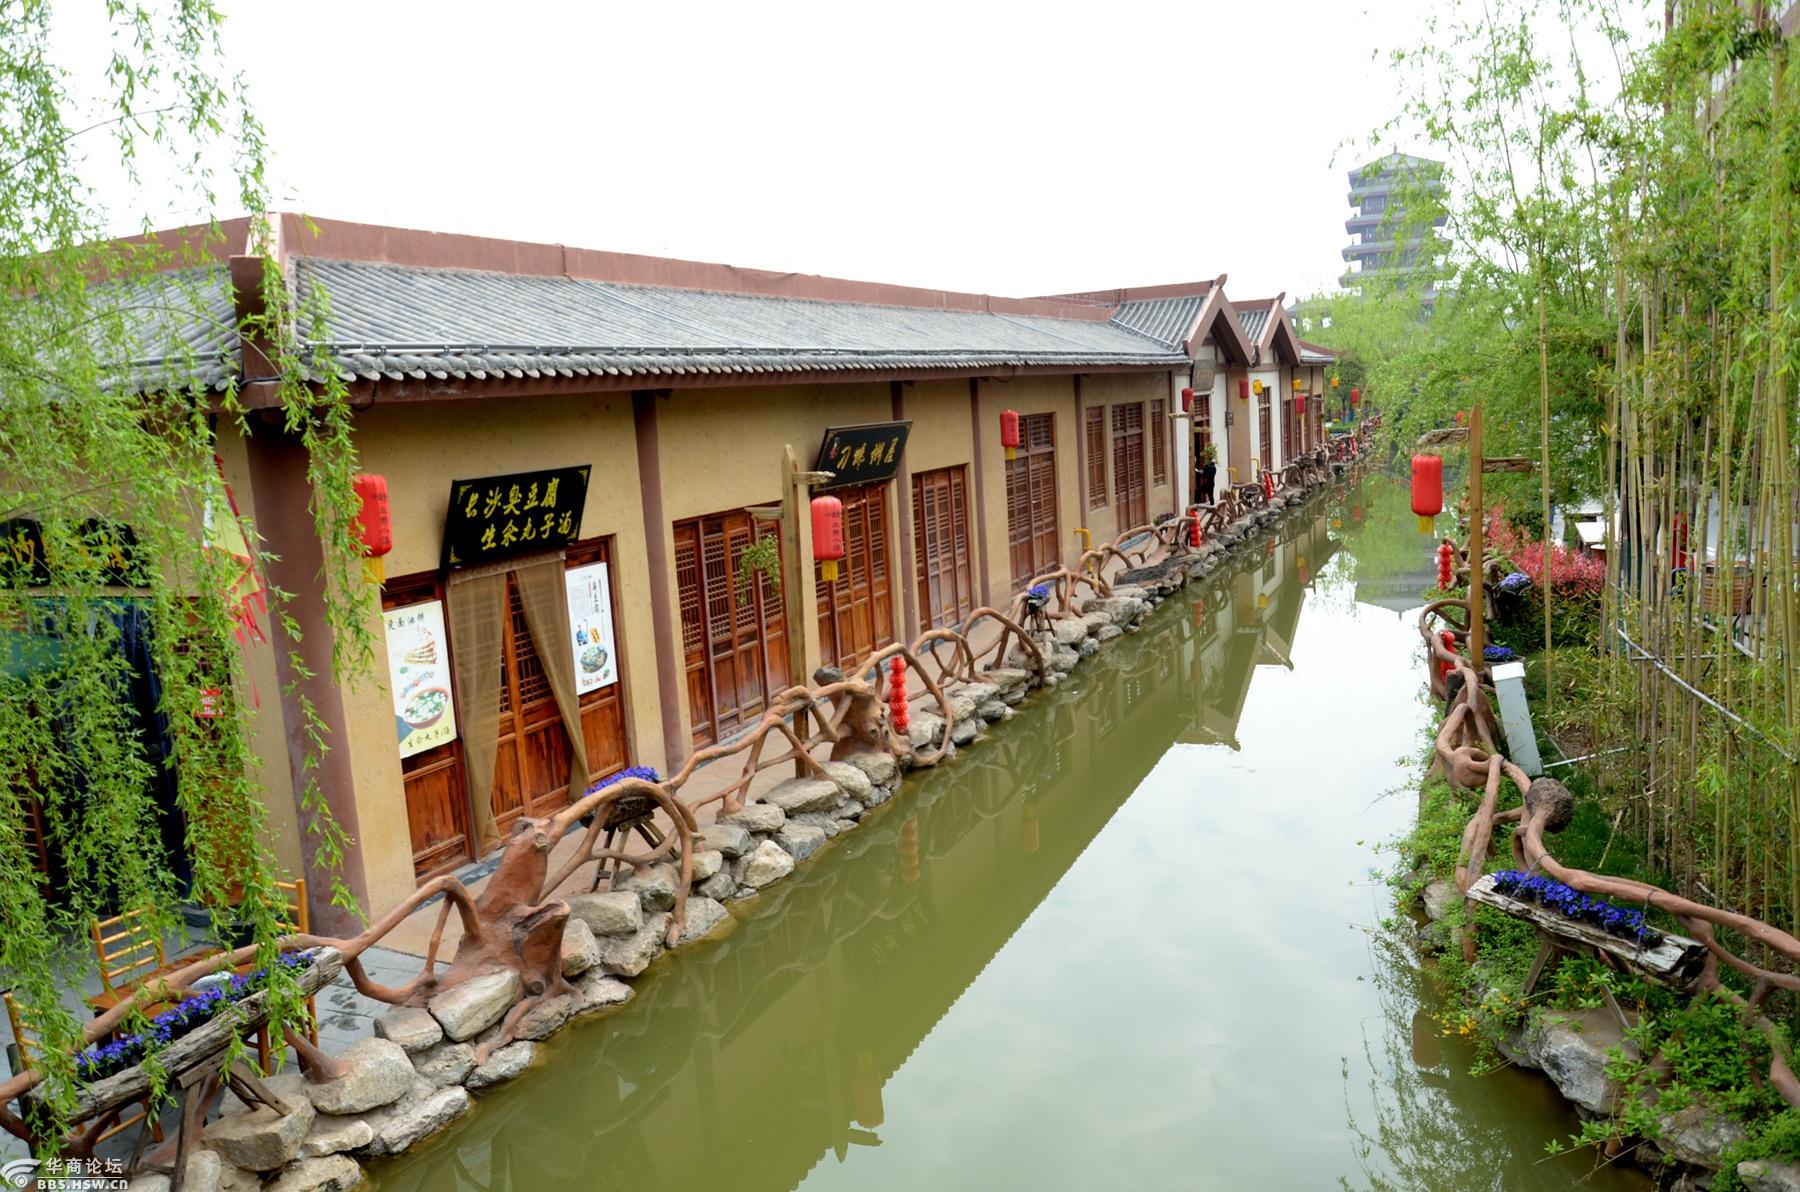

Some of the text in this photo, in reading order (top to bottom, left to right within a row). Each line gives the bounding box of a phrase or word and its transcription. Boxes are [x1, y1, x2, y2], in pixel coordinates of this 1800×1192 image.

[465, 477, 560, 519] 长沙臭豆腐
